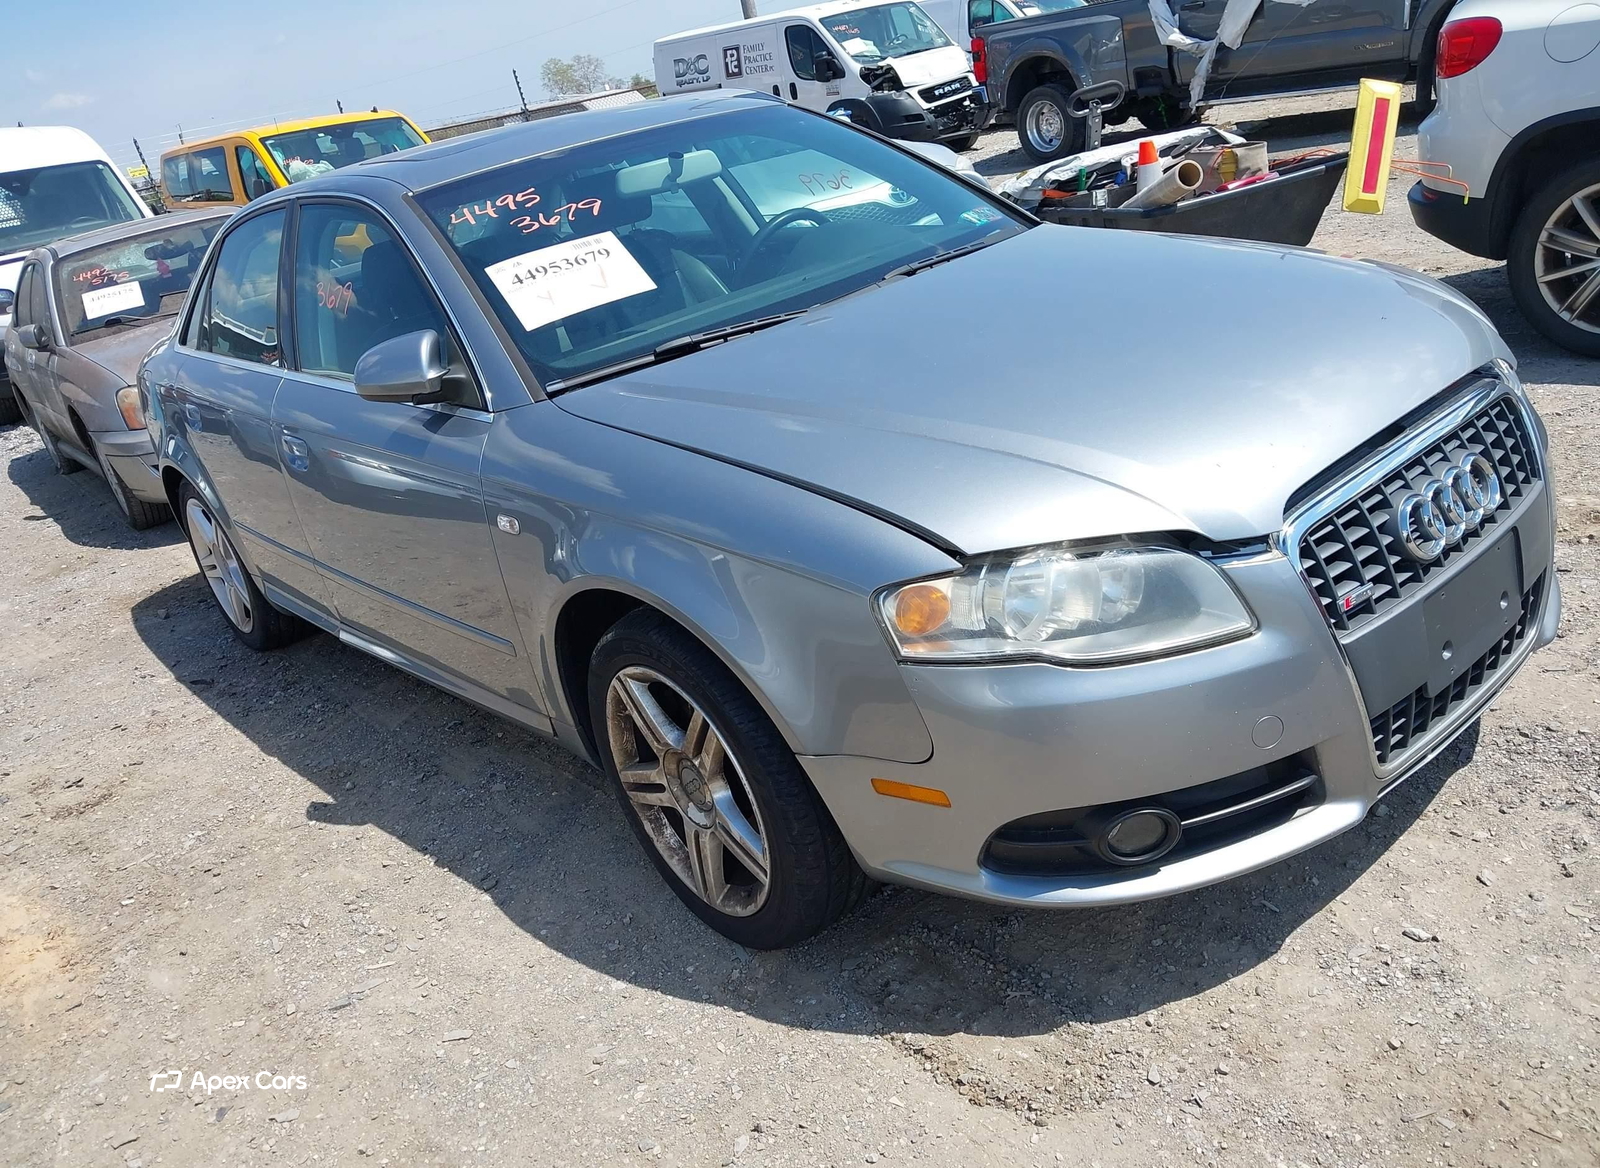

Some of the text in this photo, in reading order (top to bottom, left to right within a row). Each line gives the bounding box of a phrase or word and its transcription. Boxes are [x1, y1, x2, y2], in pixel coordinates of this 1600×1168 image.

[743, 42, 765, 54] FAMILY
[743, 52, 774, 65] PRACTICE
[673, 53, 710, 79] D&C
[933, 82, 961, 96] RAM
[450, 187, 541, 225] 4495
[510, 198, 602, 234] 3679
[72, 266, 112, 282] 4492
[511, 247, 611, 285] 44953679
[316, 281, 353, 315] 3679
